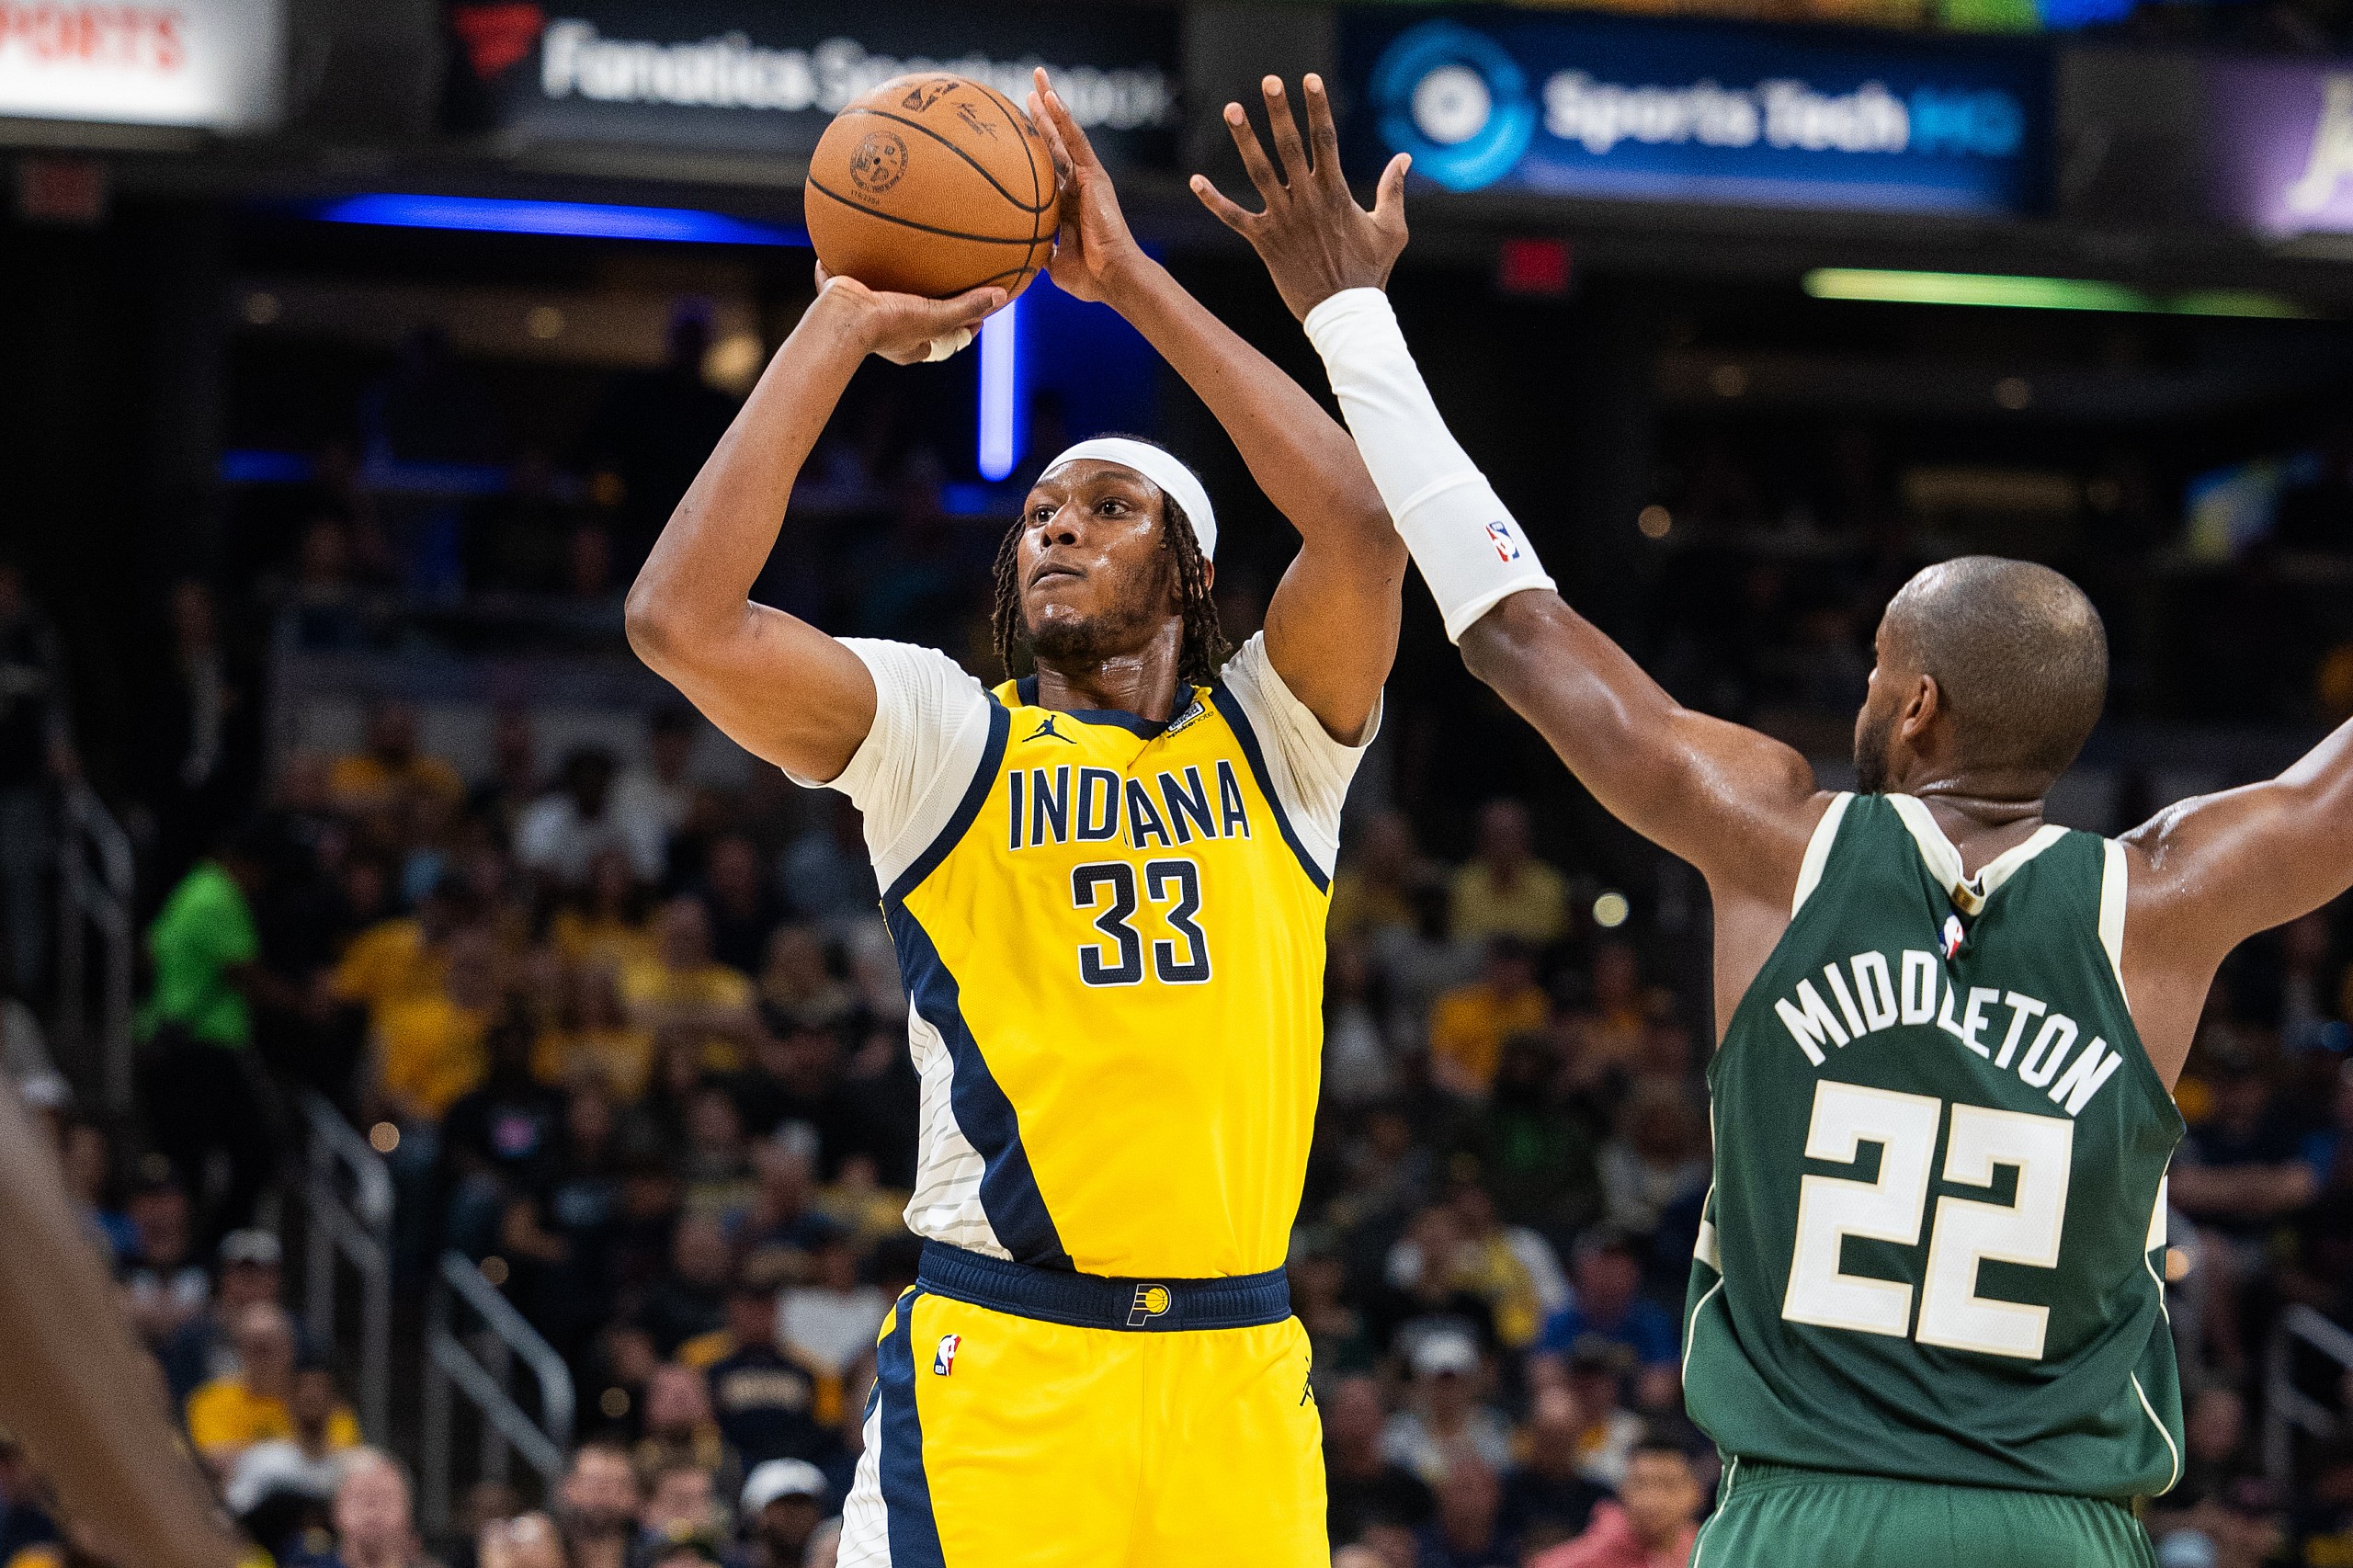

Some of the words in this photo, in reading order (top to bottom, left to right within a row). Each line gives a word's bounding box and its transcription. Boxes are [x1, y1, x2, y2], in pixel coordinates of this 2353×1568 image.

[541, 18, 813, 110] Fanatics
[1544, 69, 1759, 153] Sports
[1070, 858, 1212, 988] 33
[1774, 949, 2123, 1118] MIDDLETON
[1781, 1079, 2075, 1360] 22
